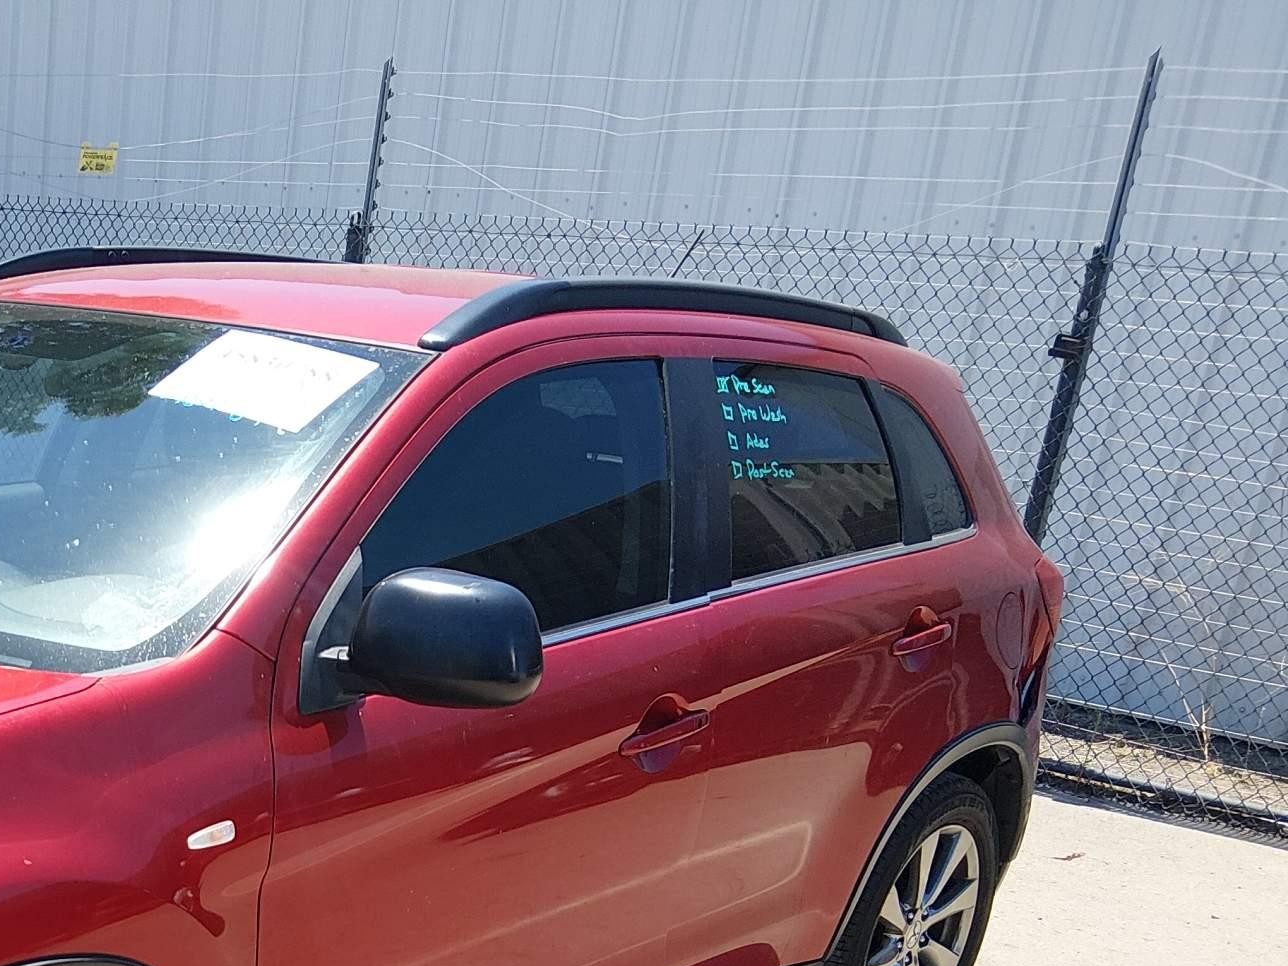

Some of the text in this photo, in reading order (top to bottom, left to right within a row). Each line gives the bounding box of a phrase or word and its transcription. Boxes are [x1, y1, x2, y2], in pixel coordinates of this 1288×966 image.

[731, 374, 776, 395] Pre Scan
[738, 402, 787, 424] Pre Wash
